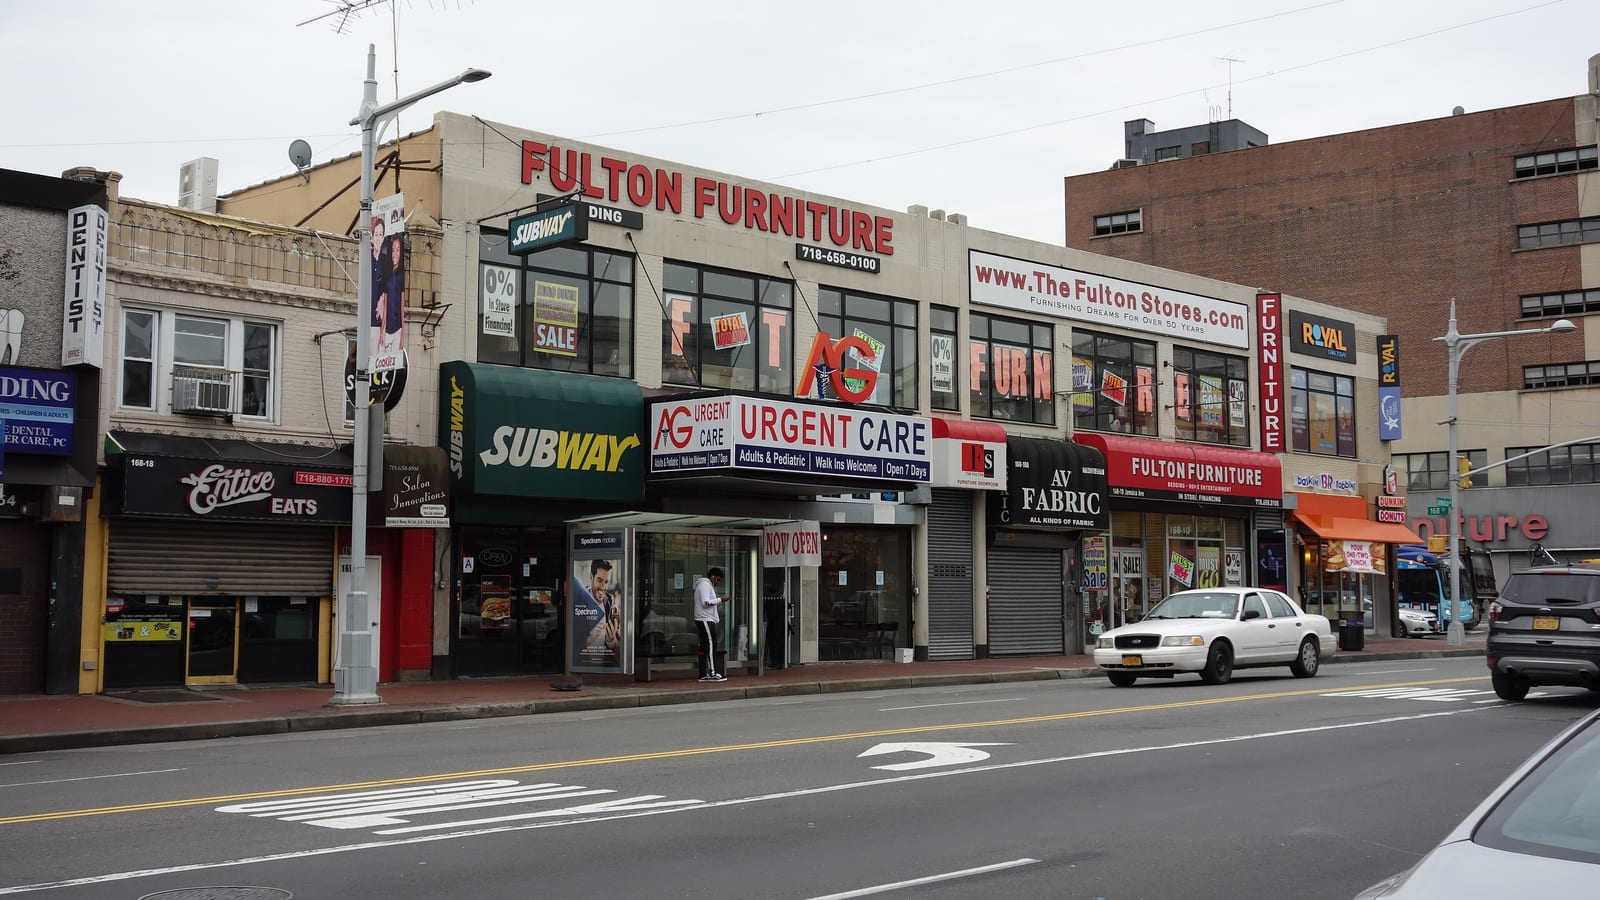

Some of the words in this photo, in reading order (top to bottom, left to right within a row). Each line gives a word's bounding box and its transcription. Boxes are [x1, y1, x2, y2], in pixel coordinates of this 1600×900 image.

[520, 139, 682, 214] FULTON
[694, 176, 895, 256] FURNITURE
[512, 209, 572, 246] SUBWAY
[801, 245, 877, 271] 718-658-0100
[68, 211, 88, 334] DENTIST
[92, 212, 105, 335] DENTIST
[485, 268, 514, 296] 0%
[488, 297, 495, 310] In
[495, 299, 510, 312] Store
[485, 316, 513, 333] Financing!
[671, 298, 691, 356] F
[714, 315, 745, 334] TOTAL
[1166, 320, 1177, 329] 50
[536, 324, 575, 350] SALE
[762, 311, 787, 367] T
[1303, 322, 1348, 351] ROYAL
[933, 338, 950, 360] 0%
[797, 331, 878, 404] AG
[1382, 339, 1395, 384] ROYAL
[1262, 298, 1280, 447] FURNITURE
[1136, 367, 1153, 413] R
[1176, 373, 1189, 418] E
[15, 409, 43, 417] CHILDREN
[695, 402, 731, 422] URGENT
[1203, 411, 1221, 425] OFF
[12, 425, 54, 437] DENTAL
[450, 375, 464, 480] SUBWAY
[653, 406, 693, 450] AG
[740, 403, 852, 449] URGENT
[859, 416, 926, 456] CARE
[21, 435, 51, 447] CARE,
[53, 438, 67, 447] PC
[700, 428, 724, 447] CARE
[479, 425, 641, 472] SUBWAY
[739, 449, 764, 463] Adults
[765, 453, 772, 464] &
[773, 452, 806, 467] Pediatric
[131, 458, 154, 468] 168-18
[815, 456, 833, 469] Walk
[834, 457, 845, 470] Ins
[846, 458, 878, 473] Welcome
[886, 462, 904, 476] Open
[904, 464, 910, 475] 7
[910, 464, 927, 479] Days
[1132, 457, 1184, 479] FULTON
[1187, 463, 1262, 486] FURNITURE
[401, 474, 431, 493] Salon
[1050, 469, 1072, 488] AV
[1321, 474, 1333, 489] BR
[180, 464, 276, 515] Entice
[1199, 495, 1222, 503] FINANCING
[271, 497, 318, 515] EATS
[390, 491, 447, 511] Innovations
[1022, 487, 1101, 515] FABRIC
[1030, 516, 1042, 524] ALL
[1043, 517, 1062, 525] KINDS
[1380, 511, 1405, 522] DONUTS
[580, 537, 602, 546] Spectrum
[792, 531, 819, 555] OPEN
[464, 559, 472, 569] A
[1172, 554, 1193, 571] MUST
[1199, 558, 1219, 570] MUST
[1225, 553, 1240, 567] 0%
[1346, 551, 1369, 559] ONE-TWO
[1123, 556, 1141, 574] SALE!
[1084, 569, 1106, 588] Sale
[1199, 569, 1220, 589] GO
[574, 608, 598, 616] Spectrum
